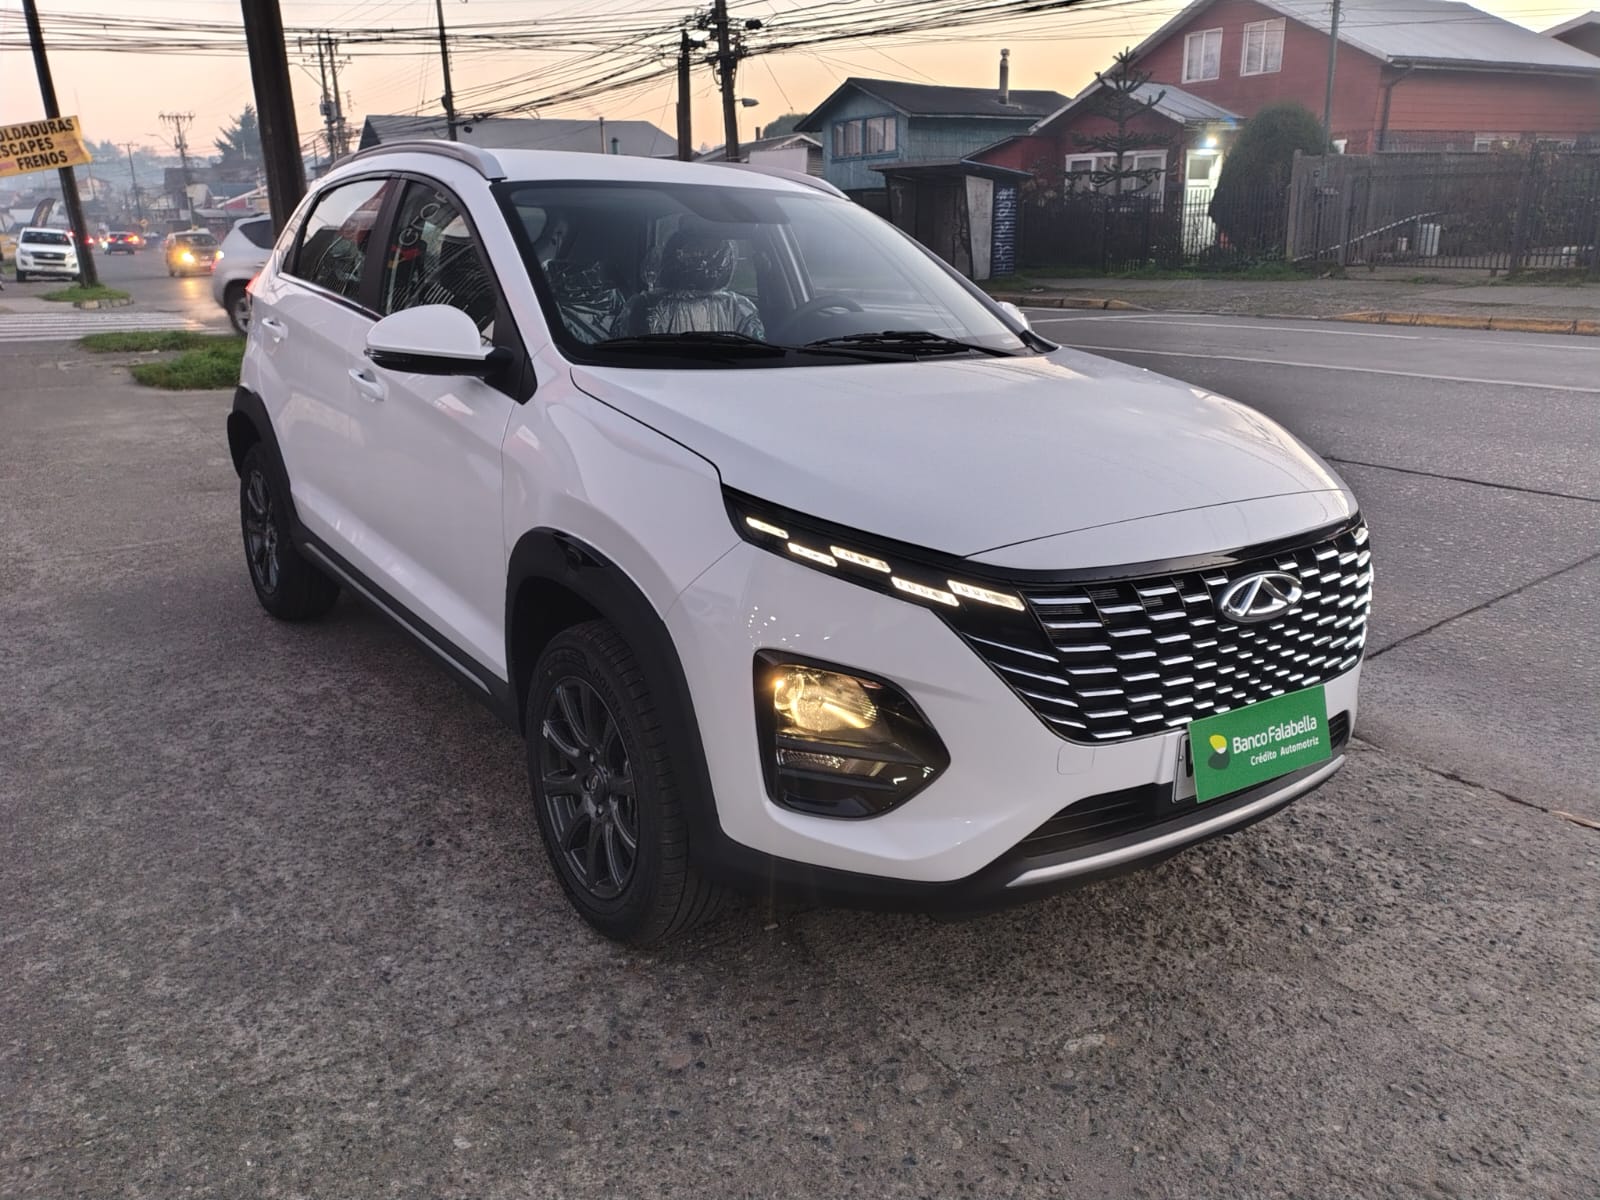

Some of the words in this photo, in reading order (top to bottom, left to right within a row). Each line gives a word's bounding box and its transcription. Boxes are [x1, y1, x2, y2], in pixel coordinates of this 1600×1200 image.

[0, 137, 54, 158] SCAPES
[16, 150, 68, 170] FRENOS
[1232, 734, 1268, 754] Banco
[1268, 715, 1317, 743] Falabella
[1250, 750, 1277, 766] Crédito
[1280, 736, 1319, 756] Automotriz
